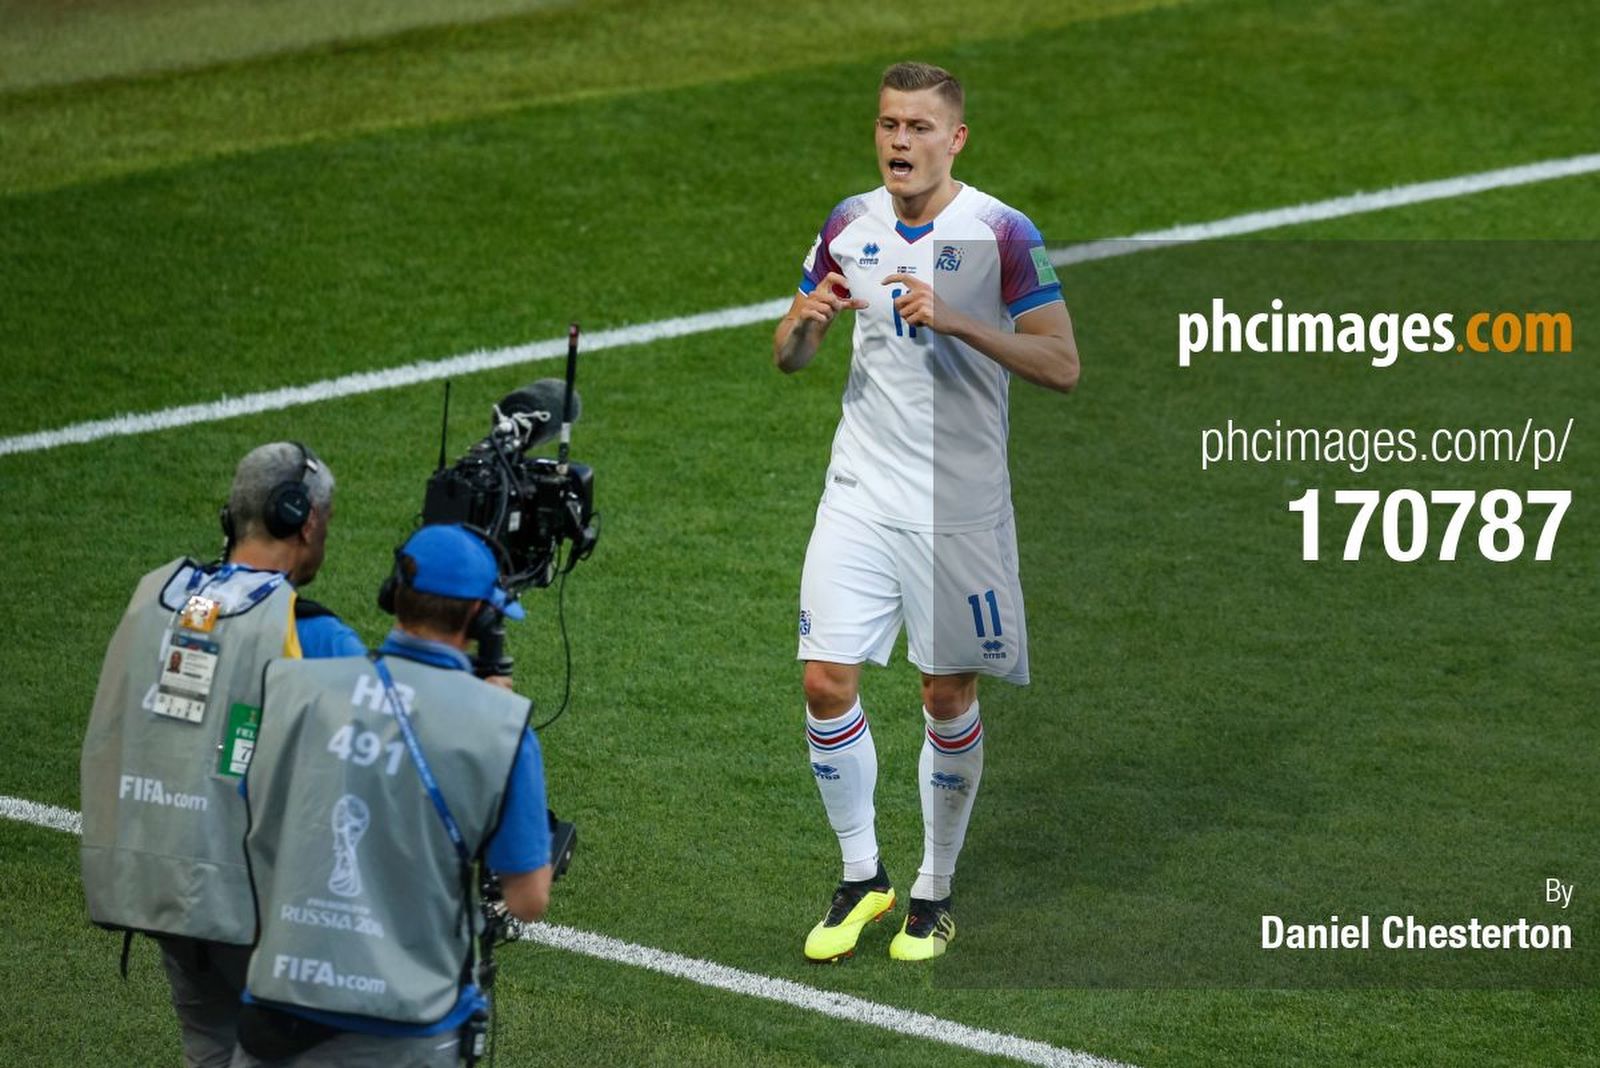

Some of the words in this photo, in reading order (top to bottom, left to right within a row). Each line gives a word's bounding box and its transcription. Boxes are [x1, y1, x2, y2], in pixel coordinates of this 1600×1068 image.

[968, 589, 1002, 638] 11
[327, 724, 405, 776] 491
[119, 775, 208, 811] FIFA.com
[281, 904, 352, 931] RUSSIA
[273, 954, 387, 995] FIFA.com
